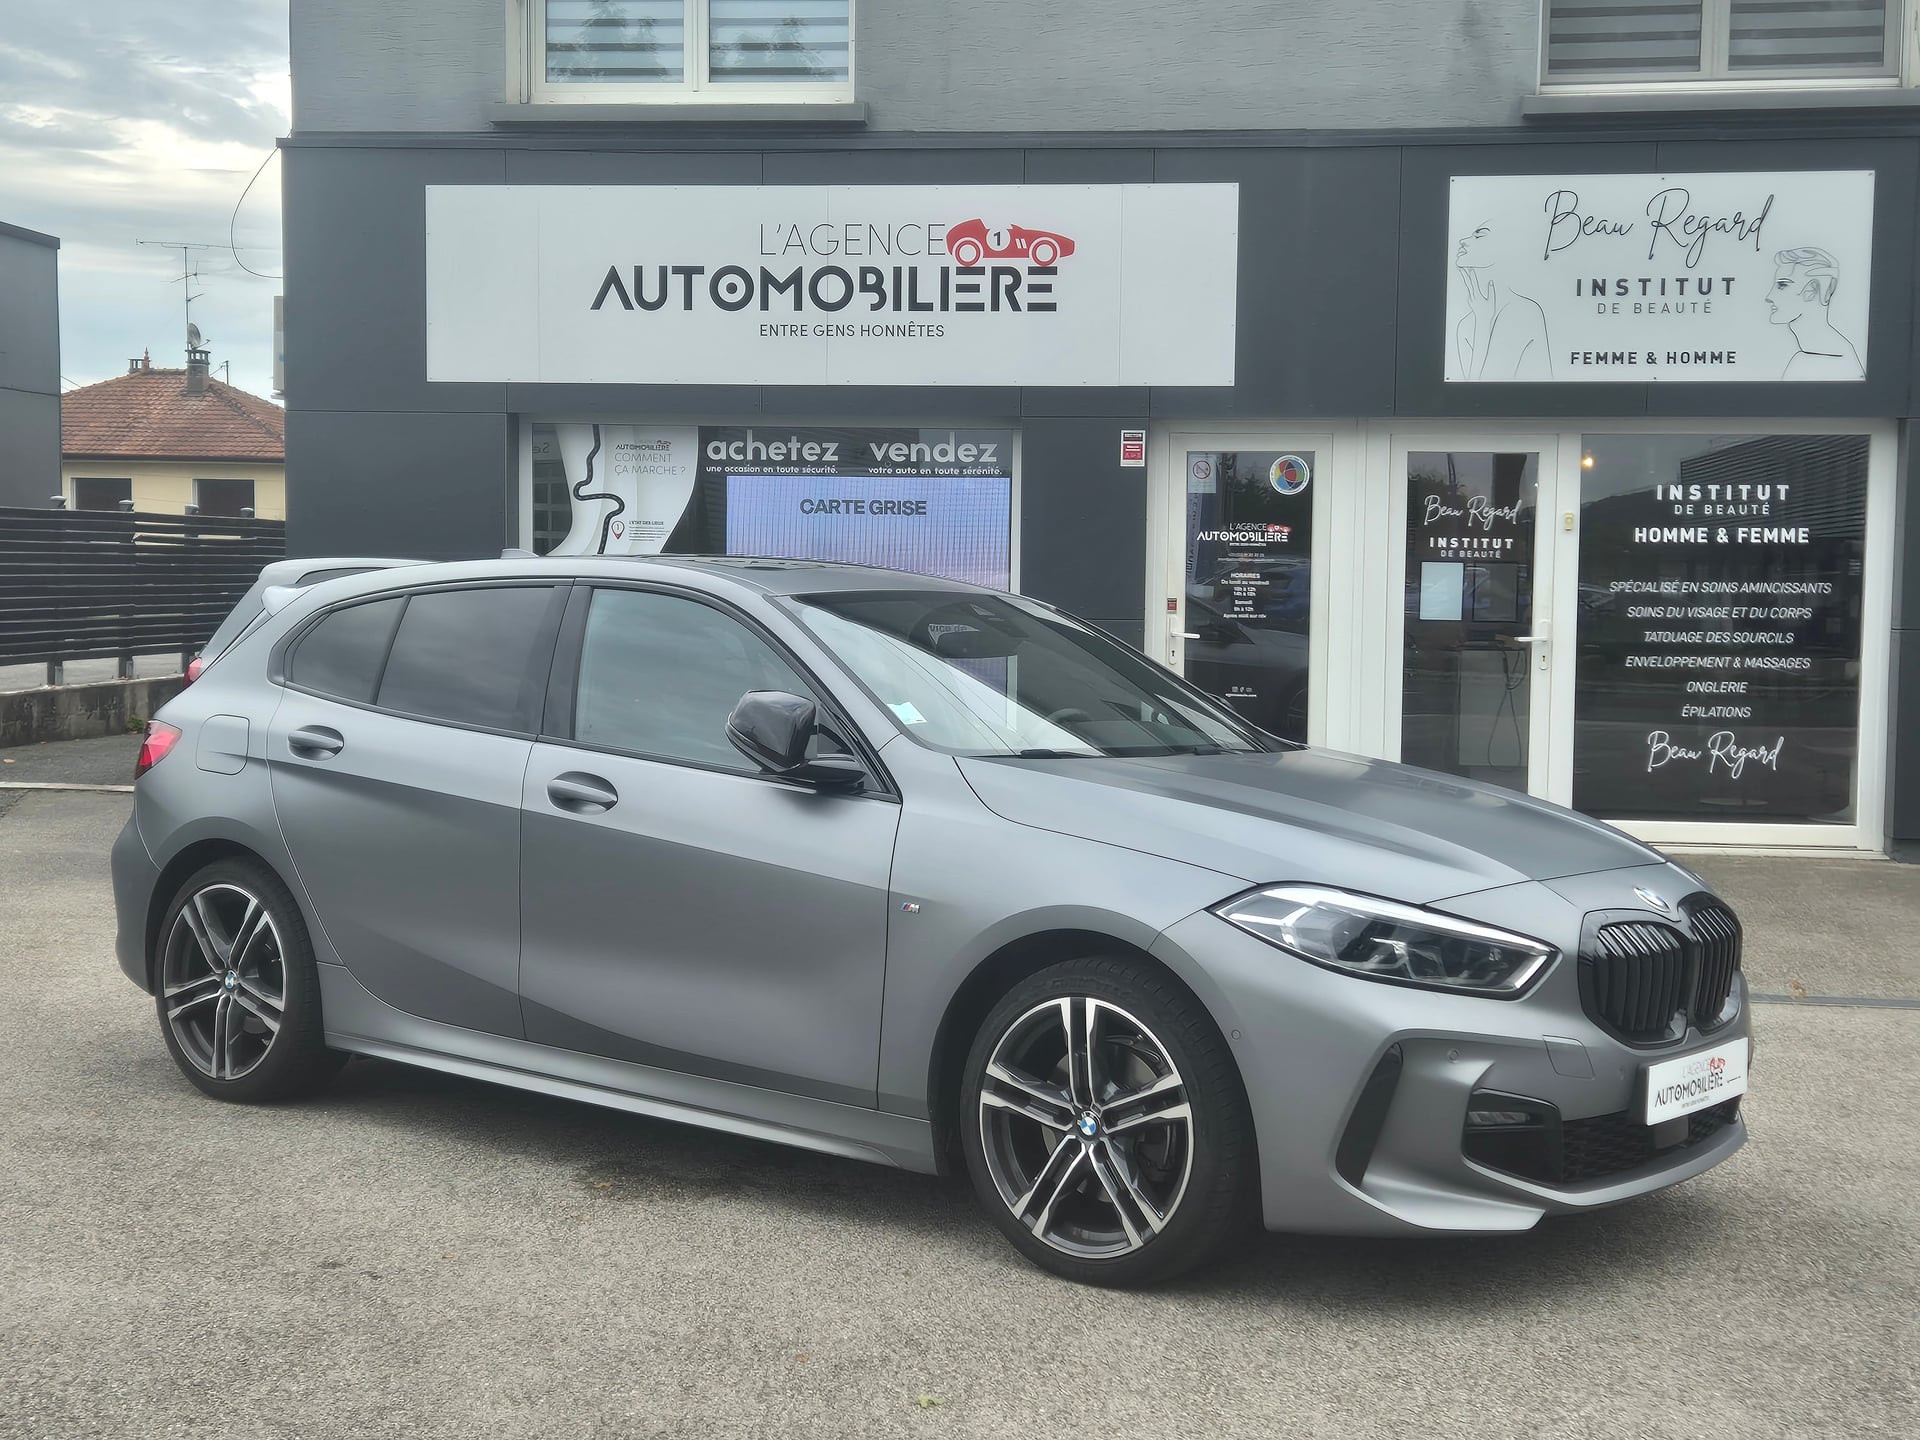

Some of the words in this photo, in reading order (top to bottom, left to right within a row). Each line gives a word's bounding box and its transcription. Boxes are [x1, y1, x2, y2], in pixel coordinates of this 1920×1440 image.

[1544, 189, 1634, 261] Beau
[1646, 188, 1774, 269] Regard
[1575, 277, 1737, 298] INSTITUT
[1597, 303, 1620, 315] DE
[1634, 299, 1713, 315] BEAUTÉ
[760, 323, 809, 338] ENTRE
[812, 323, 856, 338] GENS
[860, 319, 945, 338] HONNÊTES
[1570, 351, 1637, 365] FEMME
[1646, 352, 1657, 365] &
[1666, 351, 1737, 364] HOMME
[706, 430, 839, 462] achetez
[869, 432, 997, 463] vendez
[615, 453, 672, 462] COMMENT
[615, 465, 628, 476] ÇA
[632, 466, 677, 475] MARCHE
[725, 464, 760, 473] occasion
[777, 465, 799, 473] toute
[868, 466, 892, 474] votre
[935, 467, 959, 475] toute
[1657, 484, 1790, 501] INSTITUT
[800, 499, 865, 515] CARTE
[869, 500, 927, 516] GRISE
[1424, 495, 1463, 526] Beau
[1467, 495, 1522, 531] Regard
[1674, 504, 1694, 515] DE
[1705, 502, 1770, 515] BEAUTÉ
[1635, 527, 1708, 543] HOMME
[1717, 527, 1729, 543] &
[1738, 527, 1809, 544] FEMME
[1430, 537, 1513, 549] INSTITUT
[1441, 550, 1453, 558] DE
[1459, 549, 1501, 559] BEAUTÉ
[1609, 580, 1680, 593] SPÉCIALISÉ
[1682, 582, 1699, 593] EN
[1701, 582, 1738, 593] SOINS
[1740, 582, 1833, 594] AMINCISSANTS
[1627, 606, 1665, 618] SOINS
[1666, 607, 1684, 618] DU
[1688, 607, 1730, 618] VISAGE
[1732, 607, 1747, 618] ET
[1749, 607, 1768, 618] DU
[1770, 607, 1812, 619] CORPS
[1644, 631, 1704, 643] TATOUAGE
[1706, 632, 1730, 643] DES
[1733, 632, 1794, 643] SOURCILS
[1625, 656, 1731, 668] ENVELOPPEMENT
[1733, 657, 1741, 668] &
[1744, 657, 1811, 669] MASSAGES
[1686, 681, 1748, 693] ONGLERIE
[1682, 703, 1751, 718] ÉPILATIONS
[1647, 730, 1701, 772] Beau
[1708, 731, 1784, 779] Regard
